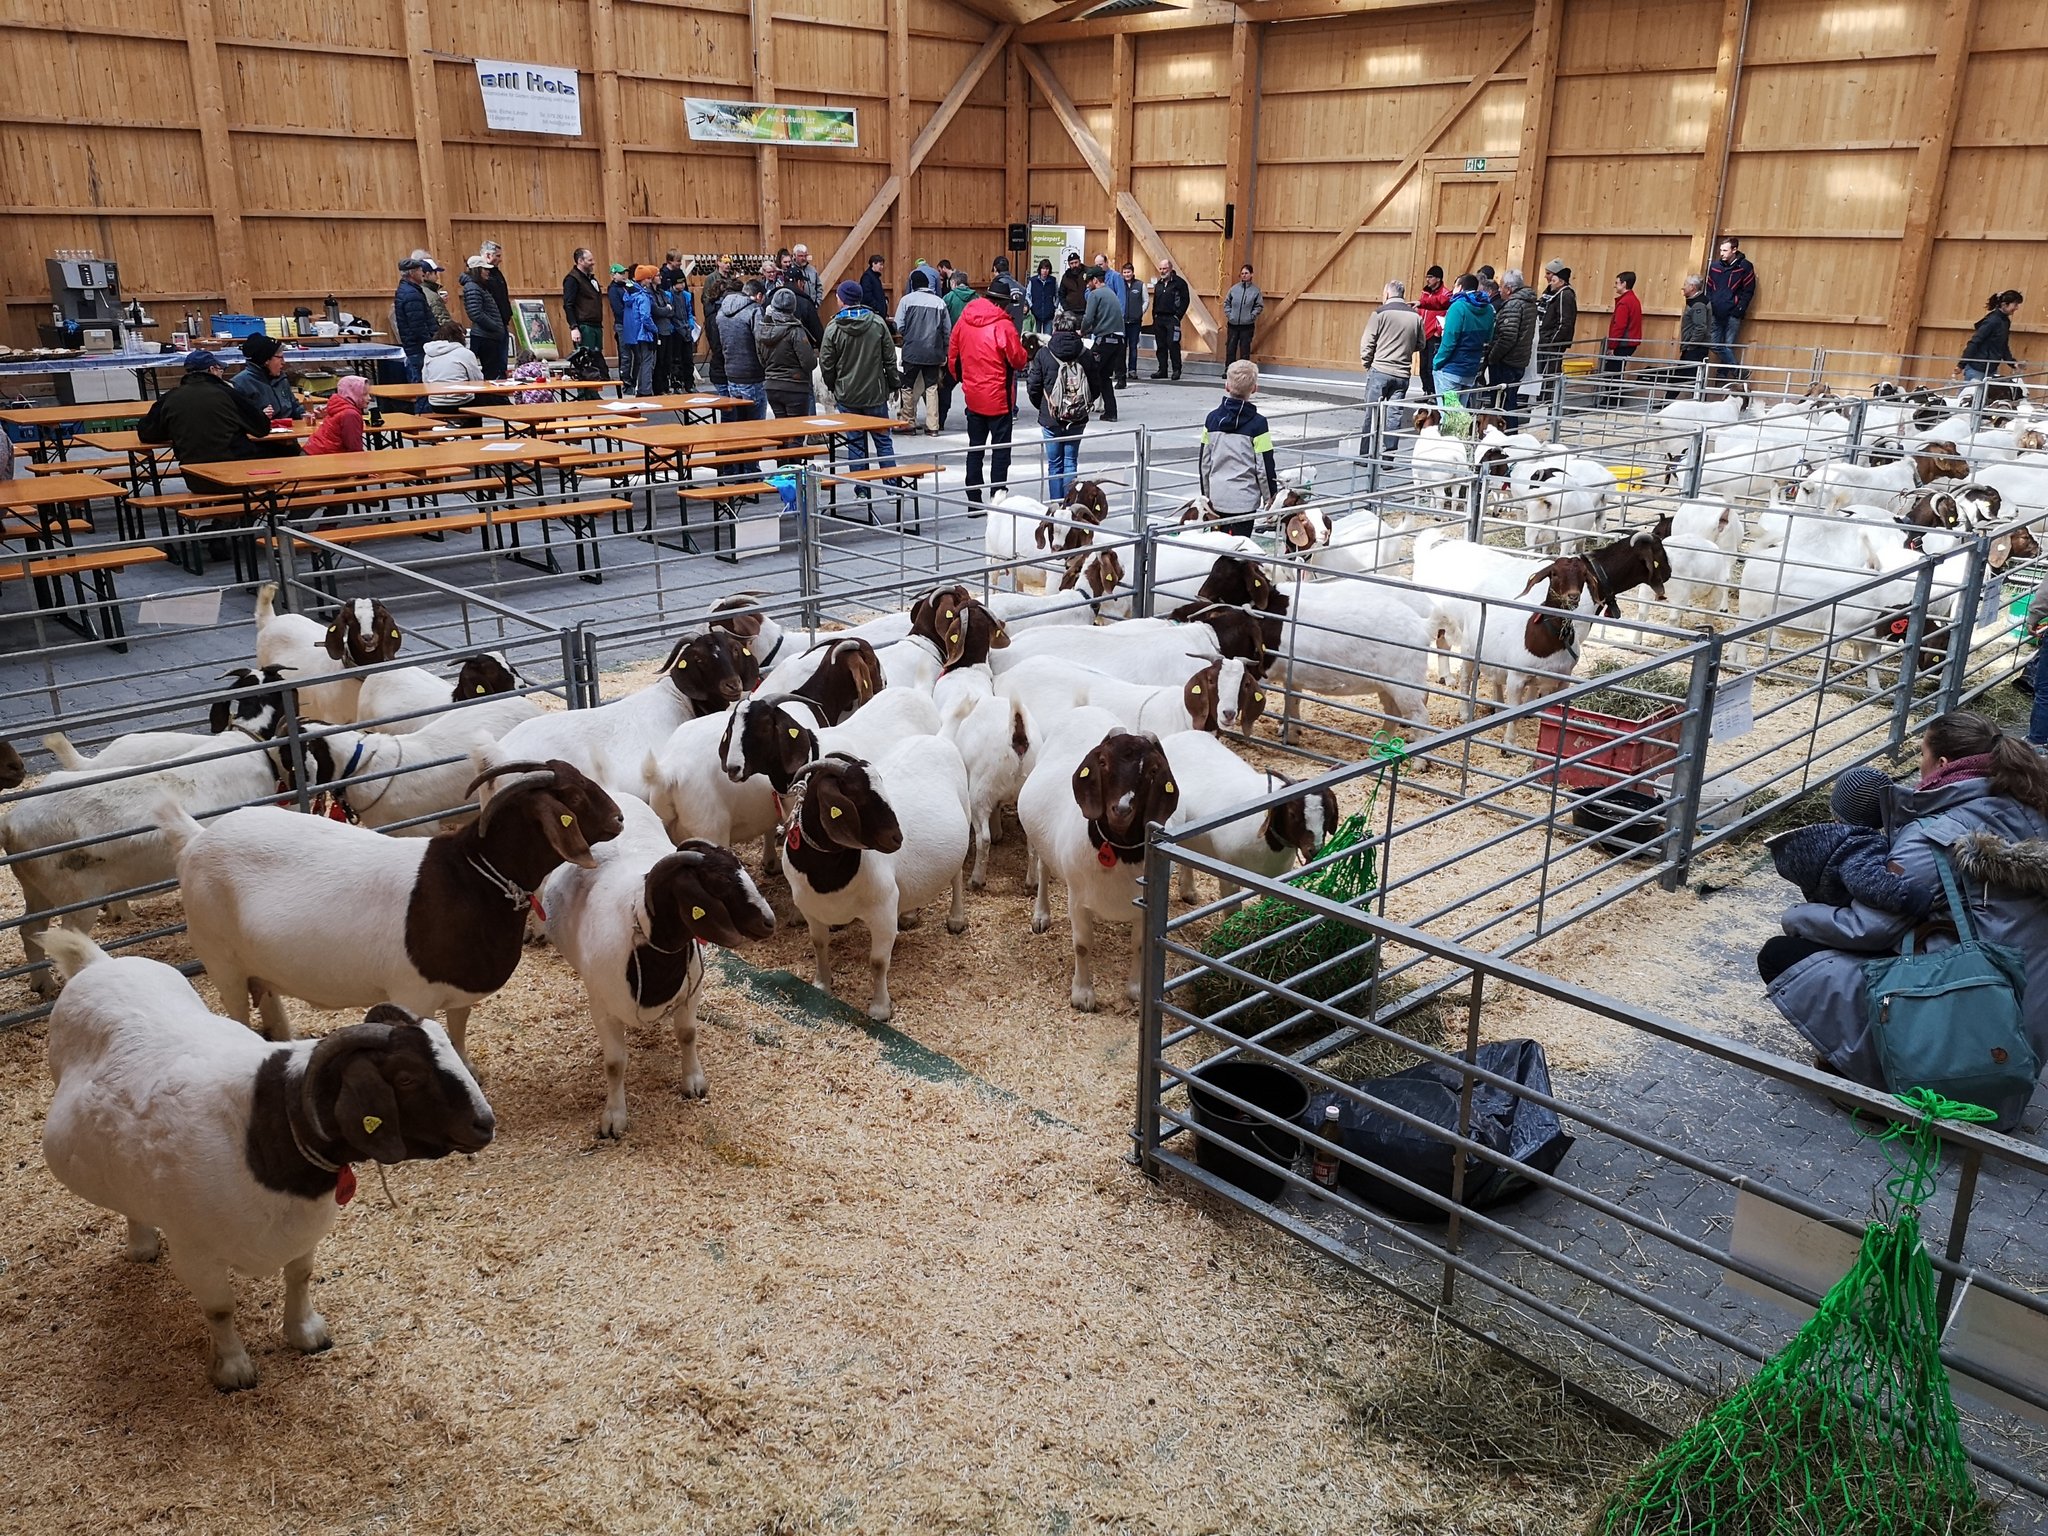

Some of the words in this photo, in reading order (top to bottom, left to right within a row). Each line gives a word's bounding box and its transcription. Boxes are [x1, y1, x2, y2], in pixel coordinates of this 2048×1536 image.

[480, 72, 520, 90] Bill
[526, 71, 576, 96] Holz
[780, 114, 806, 124] Zukunft
